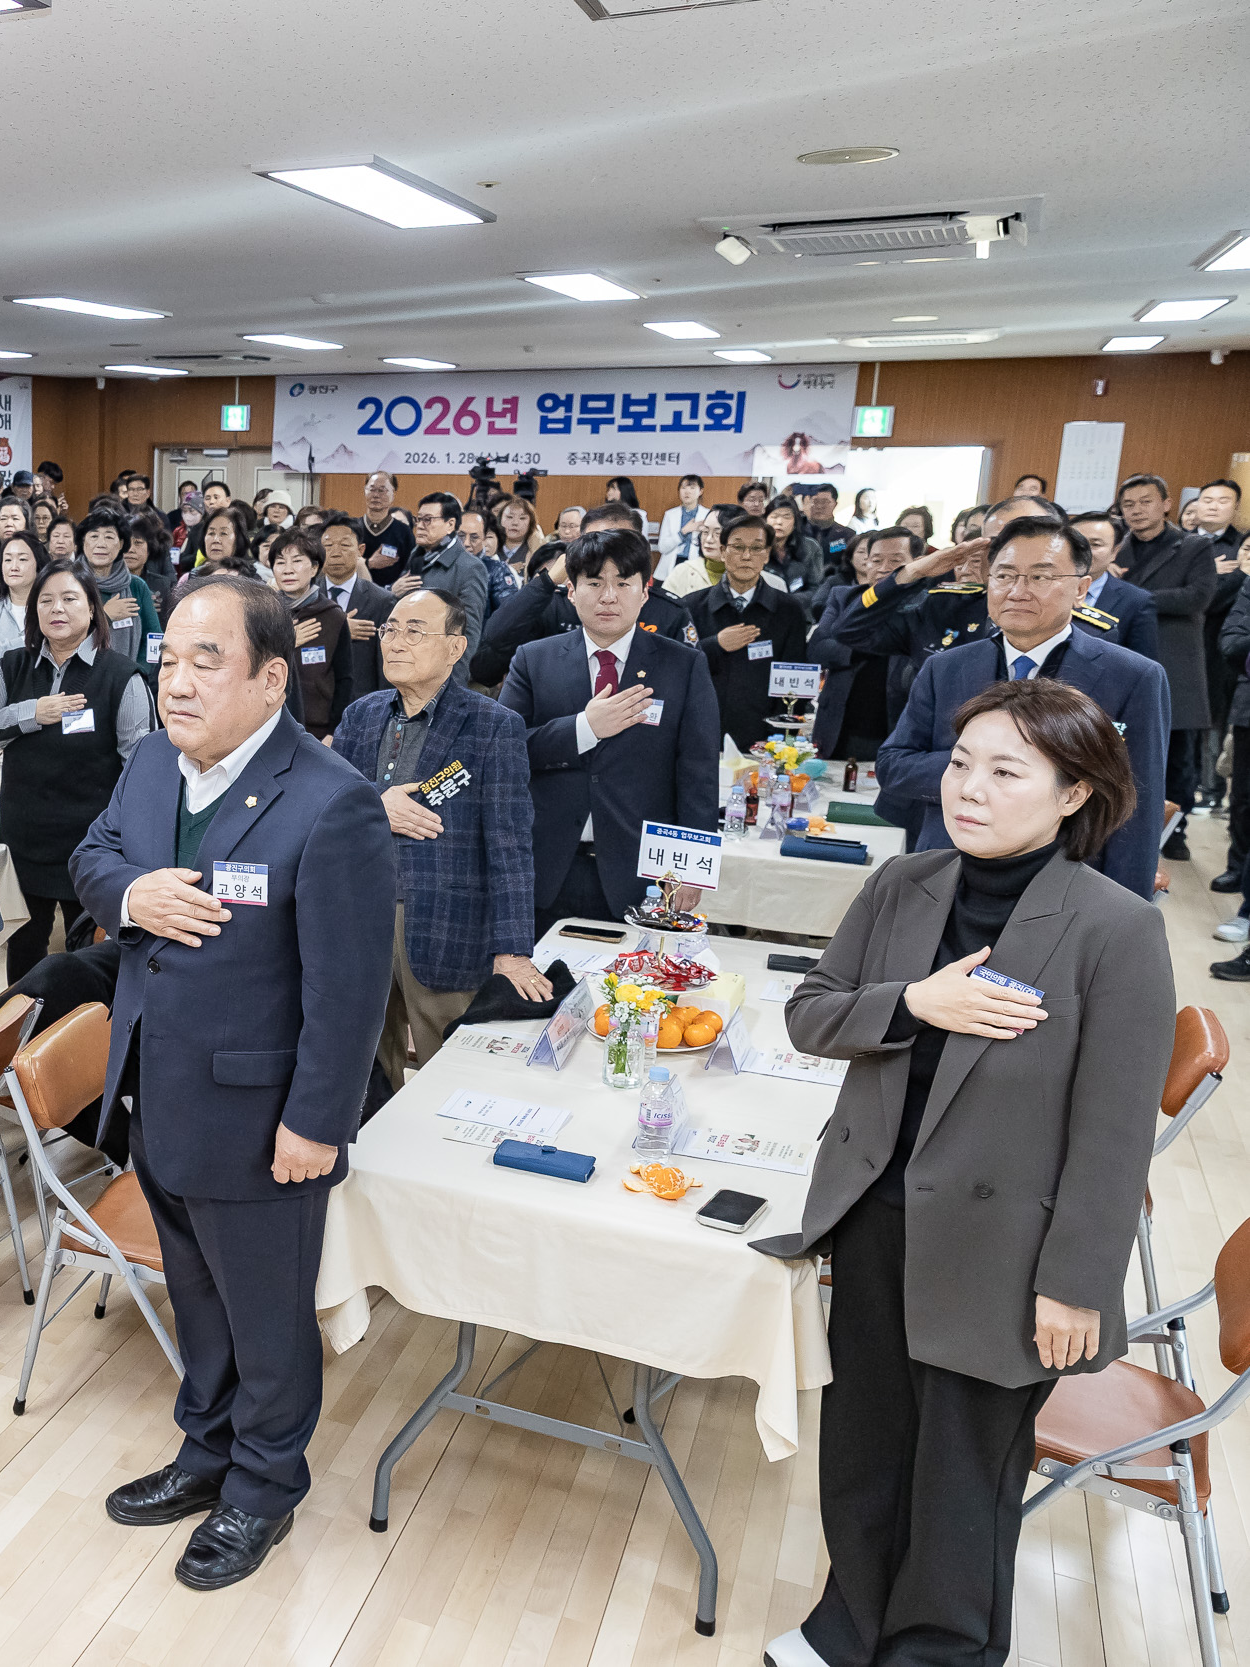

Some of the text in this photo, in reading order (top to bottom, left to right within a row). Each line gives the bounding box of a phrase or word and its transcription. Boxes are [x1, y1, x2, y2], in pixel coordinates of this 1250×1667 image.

[356, 390, 747, 436] 2026년 업무보고회
[404, 453, 440, 464] 2026.
[566, 452, 681, 466] 중곡제4동주민센터
[420, 759, 464, 794] 광진구의원
[426, 769, 472, 806] 추윤구
[656, 827, 712, 843] 중곡4동 업무보고회
[225, 863, 256, 873] 광진구의회
[648, 847, 713, 876] 내빈석
[231, 874, 250, 882] 부의장
[217, 883, 262, 900] 고양석
[979, 968, 1008, 986] 국민의힘
